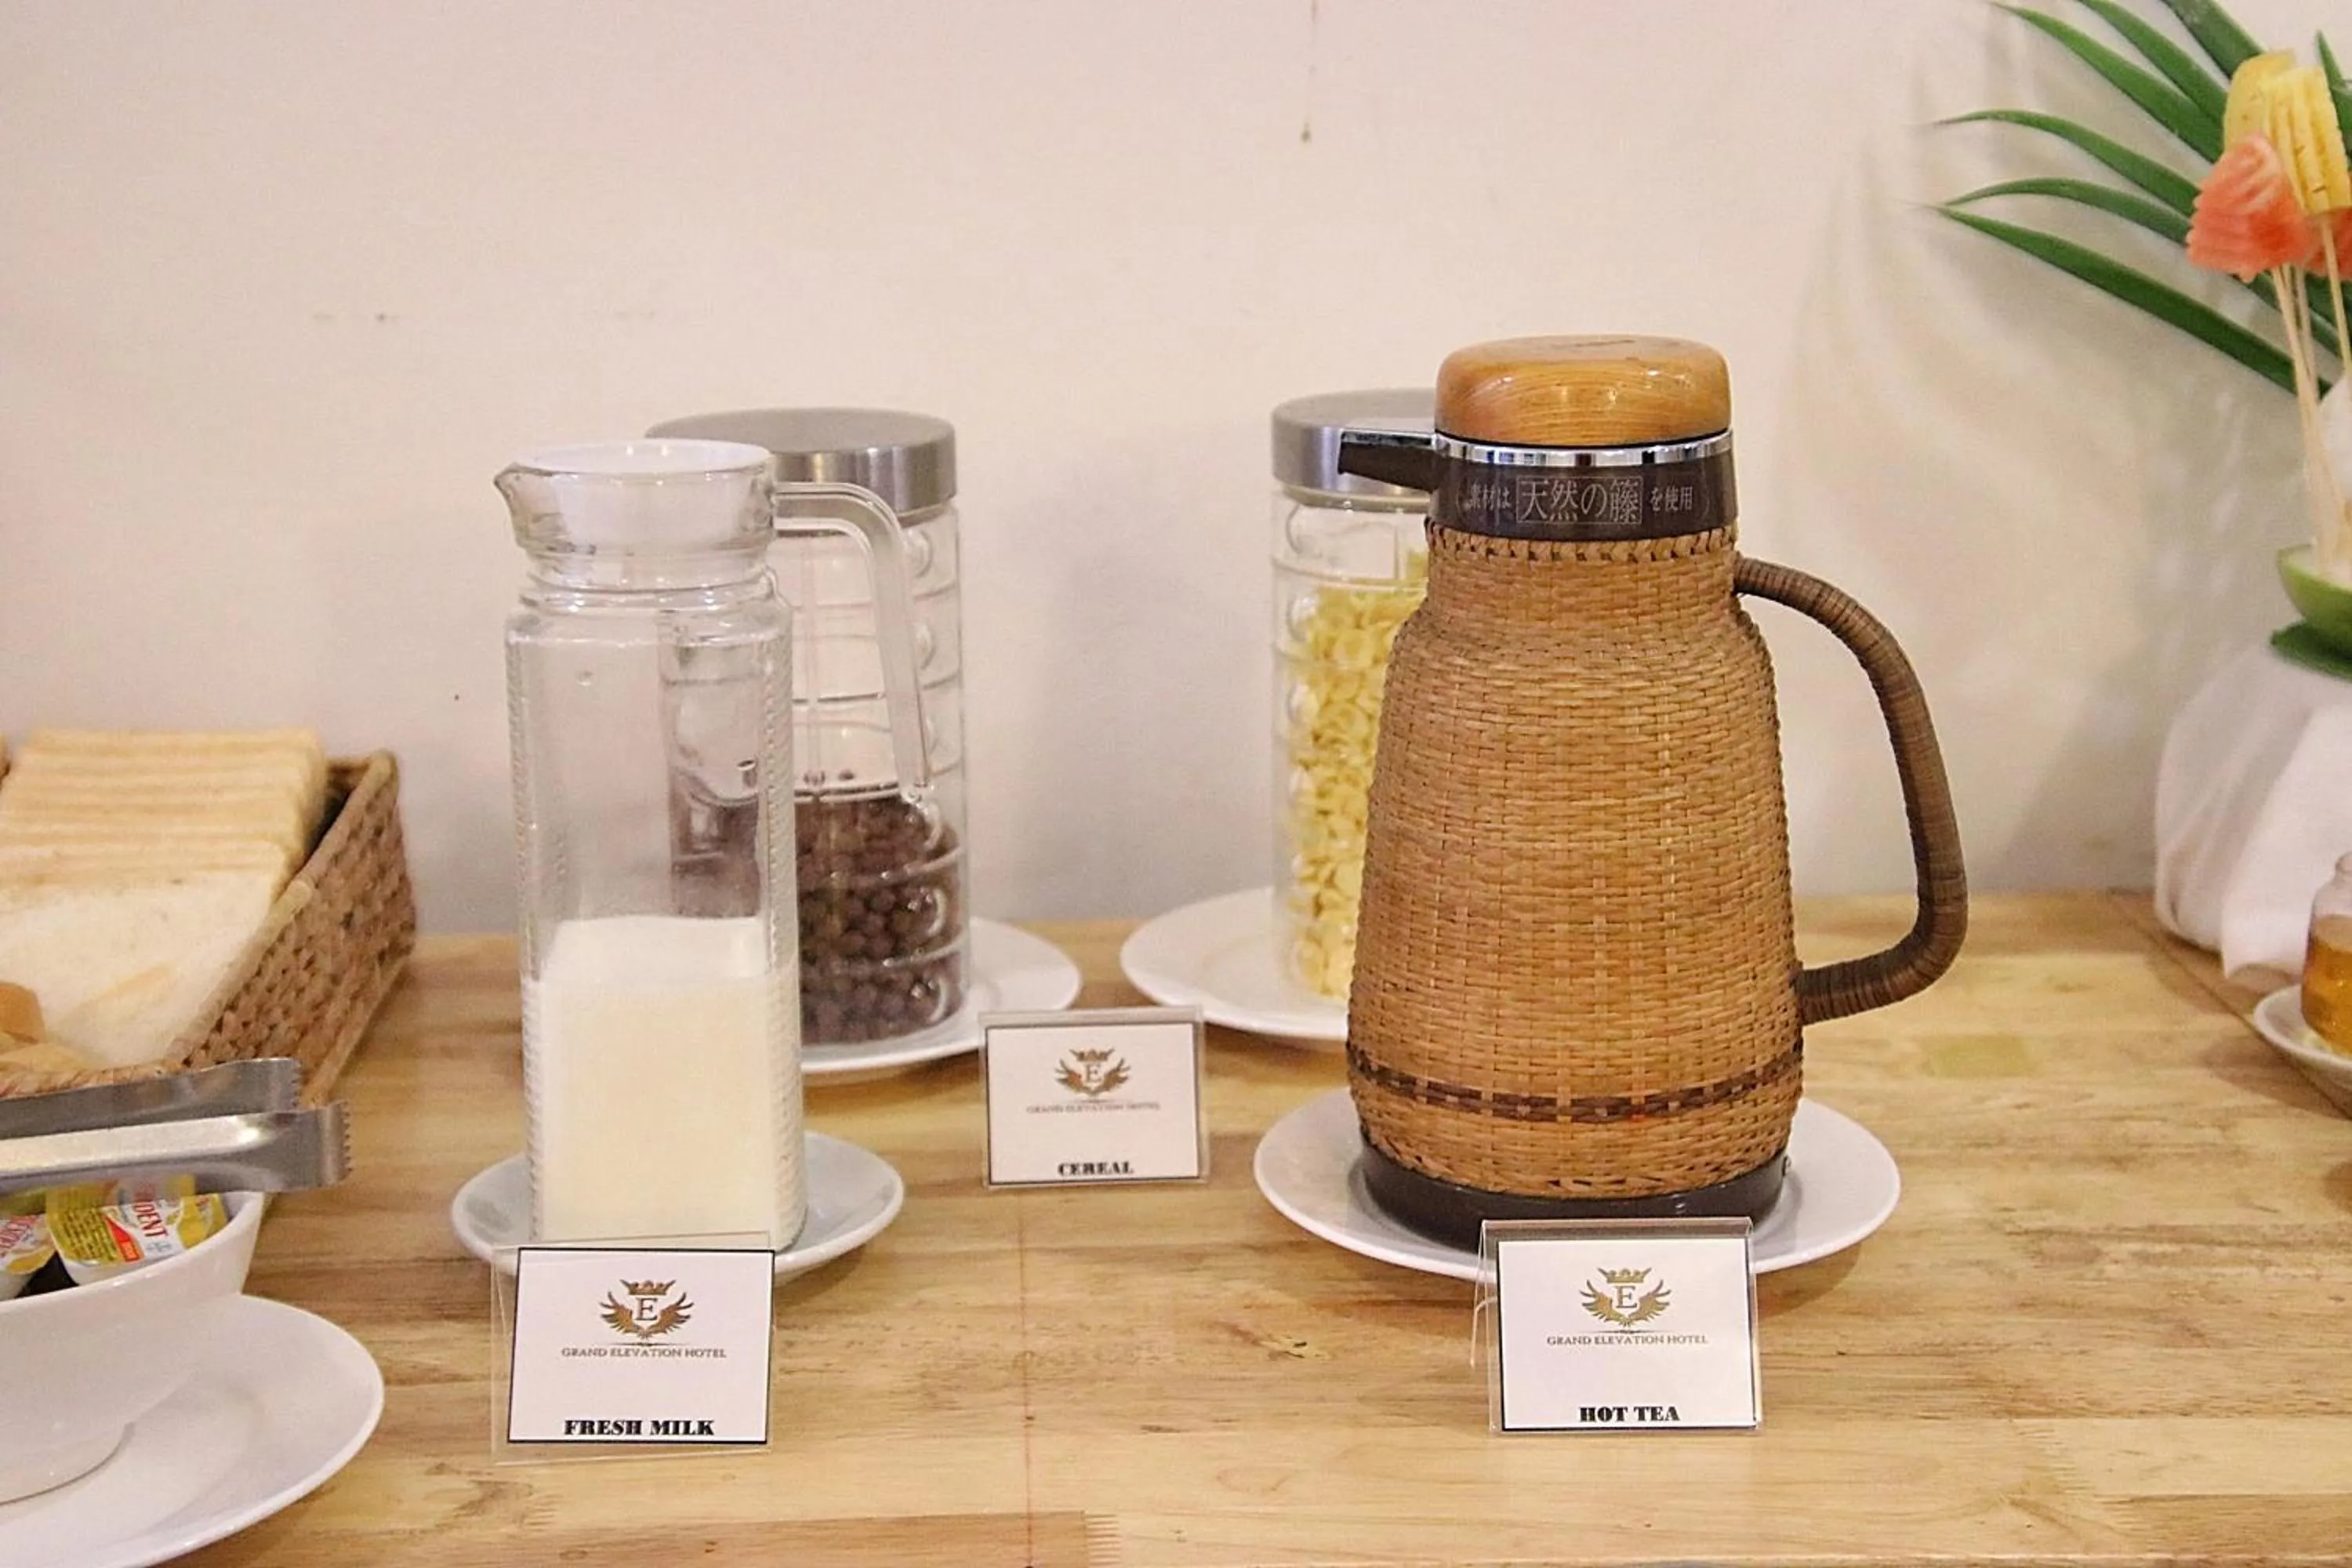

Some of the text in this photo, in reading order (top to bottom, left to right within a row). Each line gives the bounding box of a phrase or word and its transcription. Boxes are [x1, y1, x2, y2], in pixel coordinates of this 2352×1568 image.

[1085, 1063, 1102, 1083] E
[1058, 1161, 1134, 1176] CEREAL
[1615, 1285, 1639, 1308] E
[635, 1298, 659, 1321] E
[1546, 1335, 1708, 1346] GRAND ELEVATION HOTEL
[561, 1347, 727, 1359] GRAND ELEVATION HOTEL
[1579, 1406, 1681, 1423] HOT TEA
[564, 1419, 715, 1436] FRESH MILK
